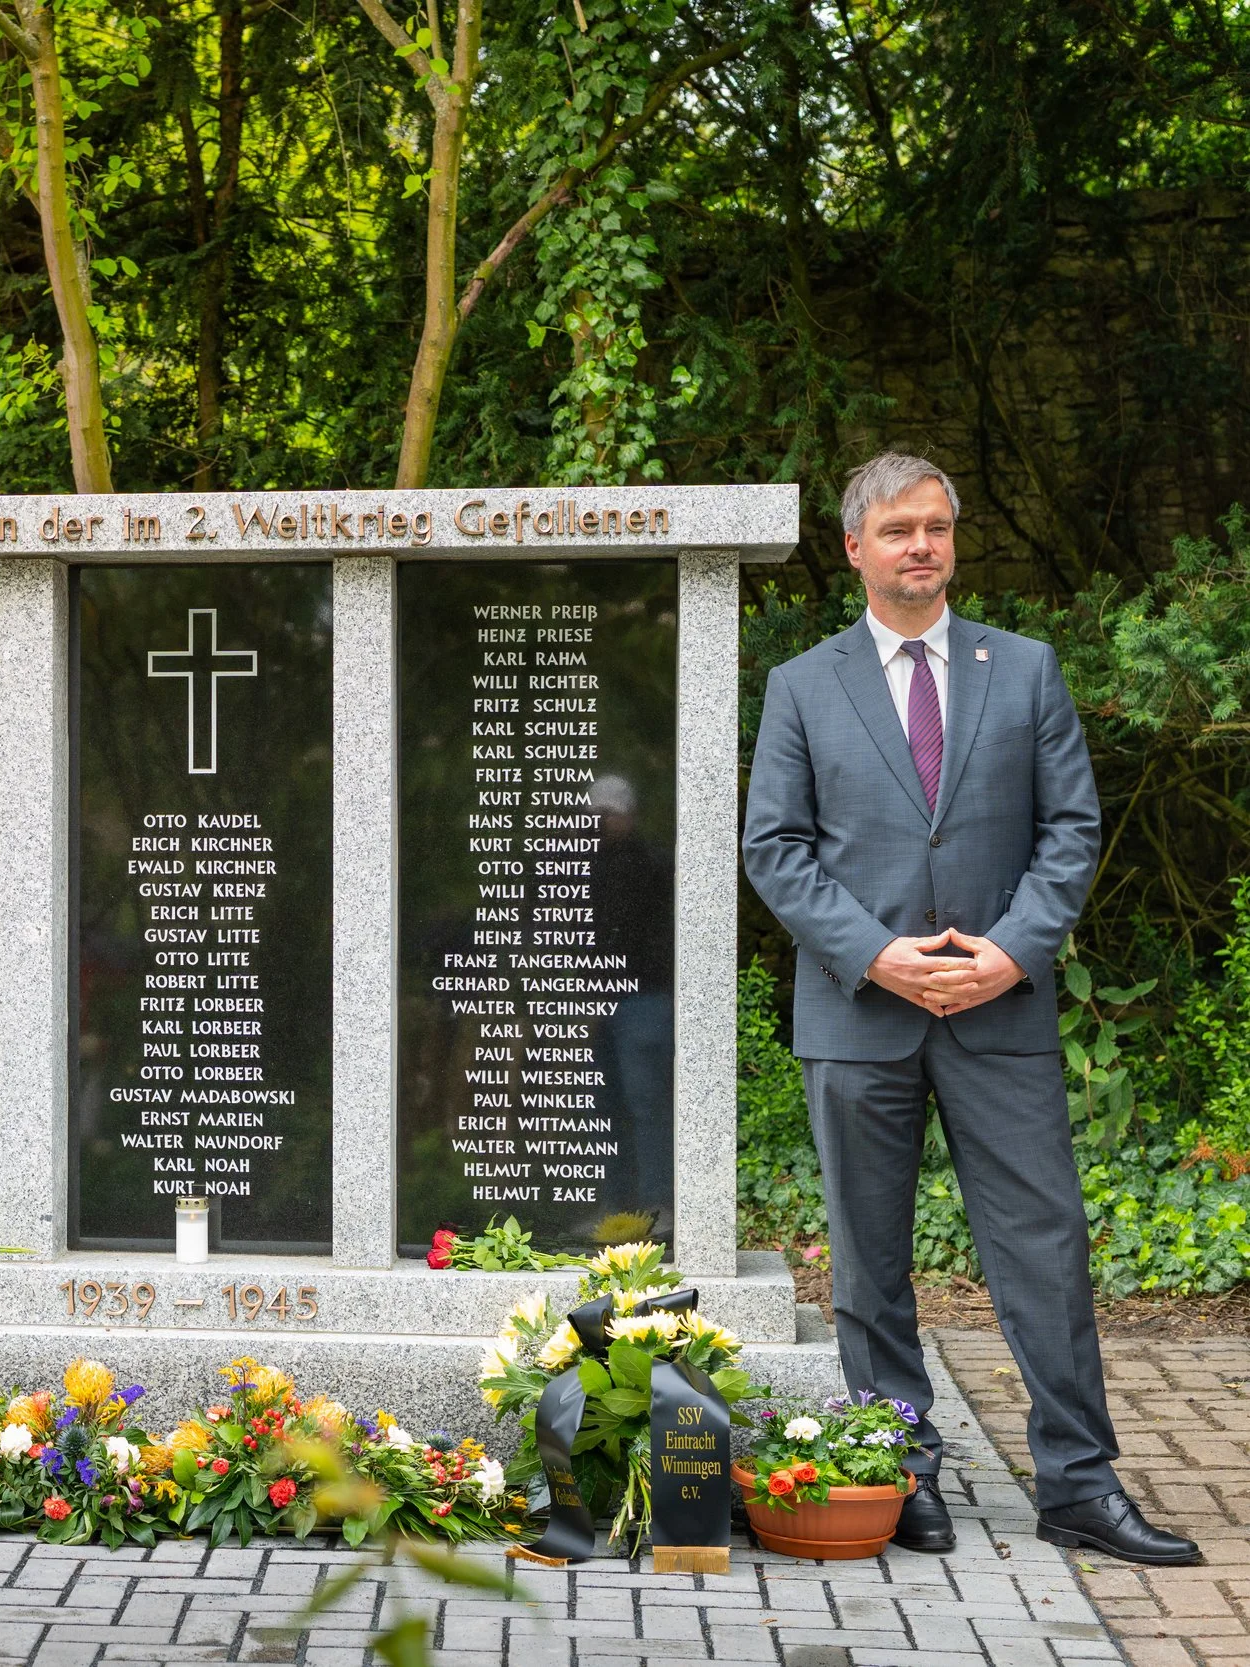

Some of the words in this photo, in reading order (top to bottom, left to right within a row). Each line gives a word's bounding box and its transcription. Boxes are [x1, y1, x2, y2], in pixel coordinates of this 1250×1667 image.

[38, 507, 103, 541] der
[123, 507, 161, 540] im
[185, 505, 218, 539] 2.
[232, 502, 434, 546] Weltkrieg
[453, 499, 669, 543] Gefallenen
[473, 604, 543, 620] WERNER
[477, 628, 527, 643] HEINZ
[536, 627, 593, 643] PRIESE
[483, 651, 527, 667] KARL
[535, 651, 588, 666] RAHM
[472, 675, 518, 690] WILLI
[529, 674, 600, 690] RICHTER
[473, 698, 520, 713] FRITZ
[532, 697, 597, 713] SCHULZ
[472, 721, 516, 736] KARL
[524, 721, 598, 737] SCHULZE
[472, 744, 516, 760] KARL
[524, 744, 599, 760] SCHULZE
[475, 767, 523, 783] FRITZ
[533, 767, 595, 783] STURM
[478, 790, 523, 807] KURT
[530, 791, 592, 806] STURM
[143, 813, 188, 829] OTTO
[197, 812, 262, 829] KAUDEL
[469, 813, 514, 829] HANS
[523, 814, 602, 829] SCHMIDT
[132, 836, 180, 852] ERICH
[190, 837, 274, 852] KIRCHNER
[469, 837, 513, 853] KURT
[523, 837, 601, 853] SCHMIDT
[127, 859, 185, 875] EWALD
[195, 859, 278, 875] KIRCHNER
[477, 860, 524, 876] OTTO
[534, 860, 591, 876] SENITZ
[138, 882, 203, 898] GUSTAV
[212, 882, 267, 898] KRENZ
[478, 884, 525, 899] WILLI
[537, 884, 591, 900] STOYE
[150, 905, 199, 921] ERICH
[210, 905, 254, 921] LITTE
[475, 907, 520, 922] HANS
[532, 907, 594, 923] STRUTZ
[143, 928, 208, 944] GUSTAV
[217, 928, 261, 944] LITTE
[473, 930, 523, 946] HEINZ
[532, 930, 597, 946] STRUTZ
[154, 951, 200, 966] OTTO
[207, 951, 251, 967] LITTE
[444, 953, 498, 969] FRANZ
[508, 953, 627, 970] TANGERMANN
[144, 974, 207, 990] ROBERT
[216, 973, 260, 990] LITTE
[431, 976, 511, 992] GERHARD
[520, 977, 639, 993] TANGERMANN
[139, 996, 186, 1012] FRITZ
[193, 997, 265, 1013] LORBEER
[451, 999, 516, 1015] WALTER
[526, 1000, 619, 1016] TECHINSKY
[141, 1019, 185, 1035] KARL
[191, 1020, 263, 1036] LORBEER
[480, 1023, 524, 1039] KARL
[532, 1023, 590, 1039] VÖLKS
[143, 1042, 182, 1058] PAUL
[189, 1043, 261, 1059] LORBEER
[474, 1046, 515, 1062] PAUL
[525, 1047, 595, 1063] WERNER
[140, 1065, 184, 1081] OTTO
[193, 1066, 264, 1082] LORBEER
[464, 1069, 510, 1085] WILLI
[520, 1070, 606, 1086] WIESENER
[109, 1087, 173, 1103] GUSTAV
[179, 1088, 295, 1105] MADABOWSKI
[473, 1092, 513, 1108] PAUL
[520, 1093, 597, 1109] WINKLER
[140, 1110, 191, 1127] ERNST
[197, 1112, 264, 1128] MARIEN
[458, 1115, 507, 1131] ERICH
[517, 1116, 612, 1133] WITTMANN
[120, 1133, 185, 1149] WALTER
[194, 1134, 284, 1151] NAUNDORF
[451, 1138, 516, 1155] WALTER
[524, 1140, 619, 1156] WITTMANN
[153, 1156, 196, 1172] KARL
[204, 1157, 250, 1173] NOAH
[463, 1162, 532, 1178] HELMUT
[542, 1163, 606, 1180] WORCH
[153, 1179, 196, 1196] KURT
[204, 1179, 251, 1196] NOAH
[472, 1185, 541, 1201] HELMUT
[552, 1186, 597, 1203] ZAKE
[59, 1278, 156, 1320] 1939
[221, 1282, 319, 1322] 1945
[677, 1406, 703, 1425] SSV
[665, 1430, 716, 1450] Eintracht
[660, 1455, 722, 1480] Winningen
